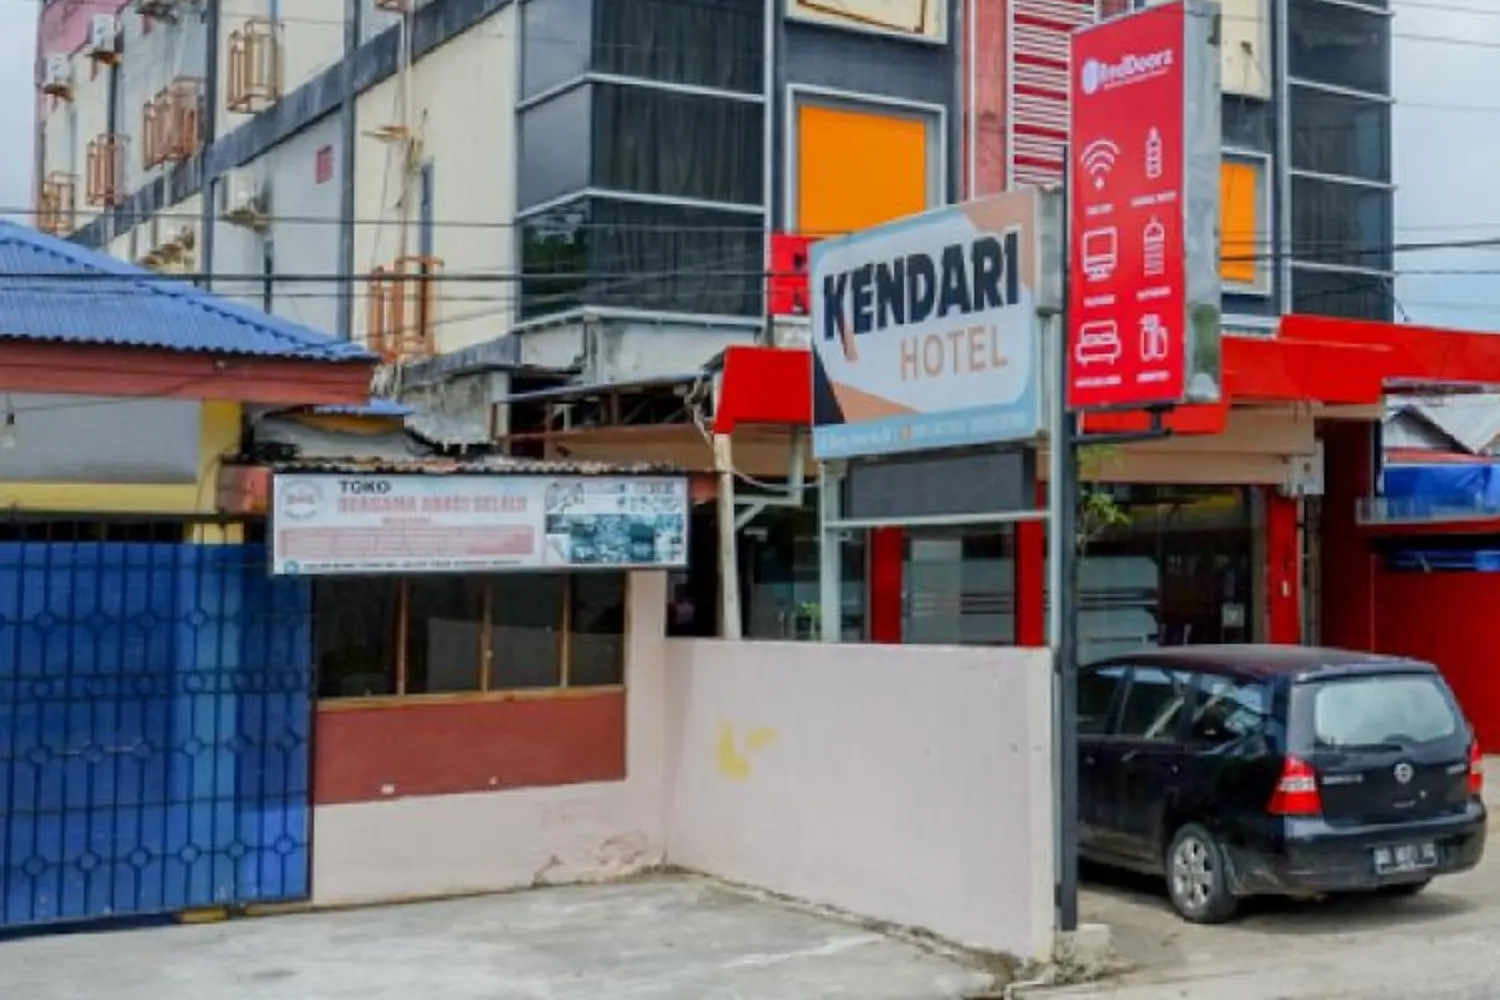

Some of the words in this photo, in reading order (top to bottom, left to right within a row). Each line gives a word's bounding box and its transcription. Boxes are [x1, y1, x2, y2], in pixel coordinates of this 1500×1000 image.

[822, 230, 1019, 358] KENDARI
[900, 324, 1008, 381] HOTEL
[338, 480, 392, 494] TOKO
